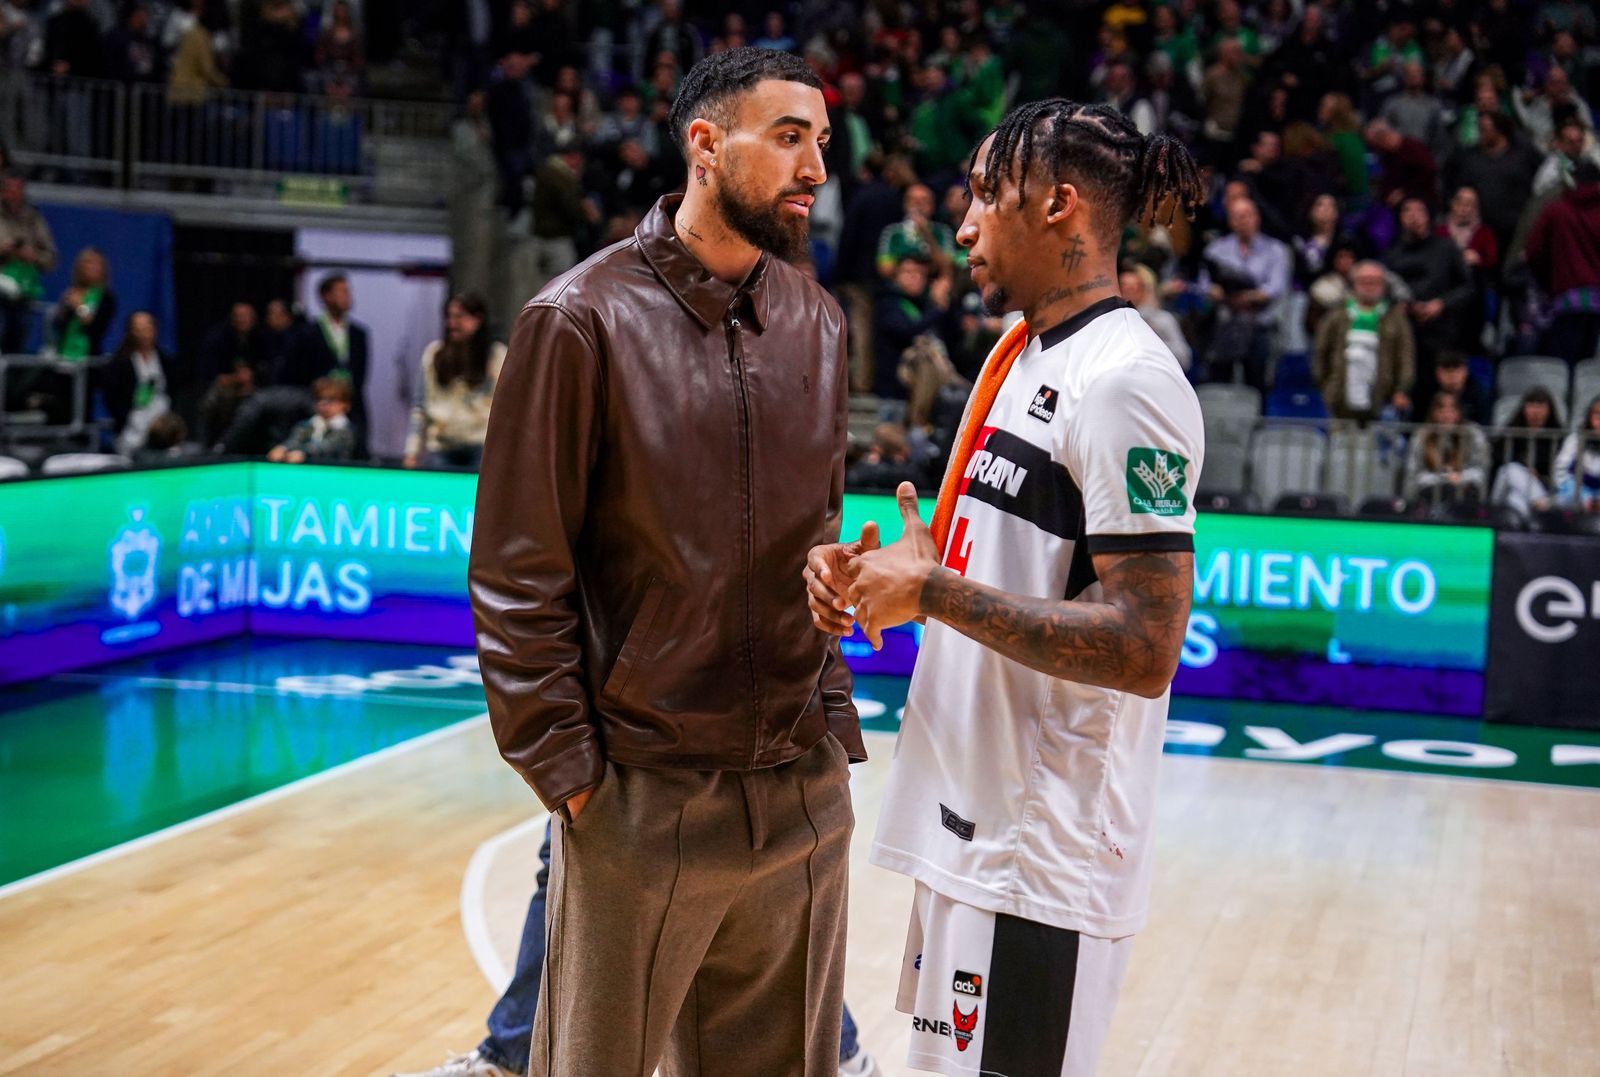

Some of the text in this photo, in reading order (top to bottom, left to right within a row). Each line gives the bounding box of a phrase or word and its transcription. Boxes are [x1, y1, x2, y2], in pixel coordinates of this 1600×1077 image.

[178, 562, 216, 616] DE
[1516, 575, 1600, 643] e
[954, 980, 976, 995] acb
